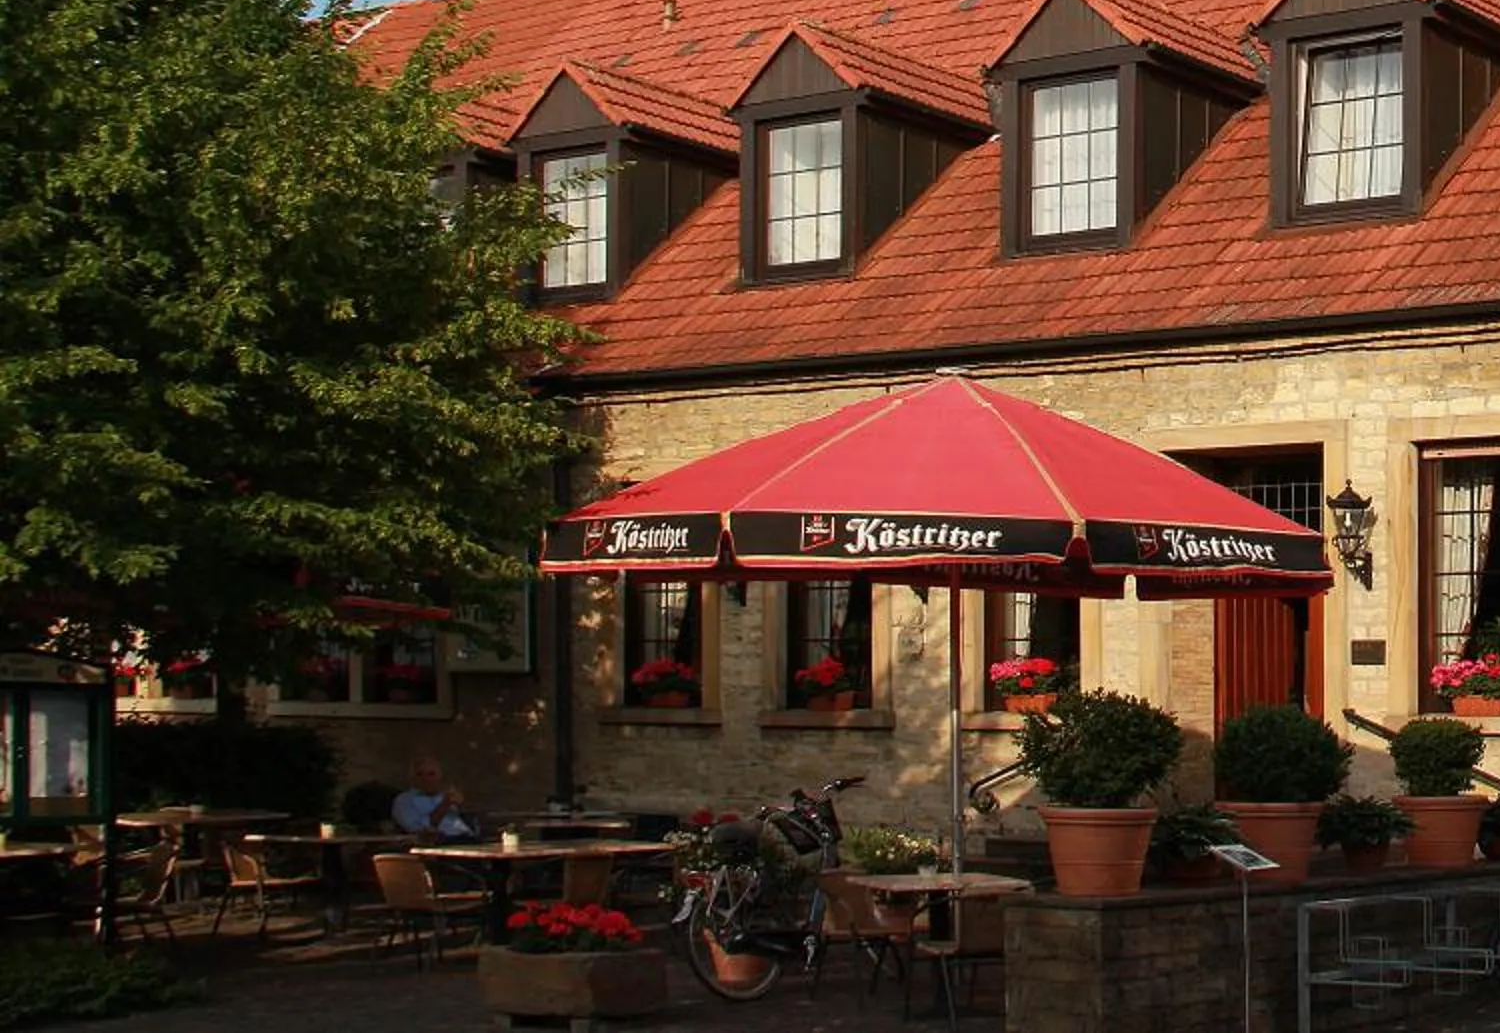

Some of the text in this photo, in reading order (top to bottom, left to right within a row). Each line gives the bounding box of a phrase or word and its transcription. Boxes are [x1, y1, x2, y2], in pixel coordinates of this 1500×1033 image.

[606, 520, 689, 554] Köstritzer
[843, 518, 1003, 553] Köstritzer
[1162, 529, 1275, 563] Köstritzer
